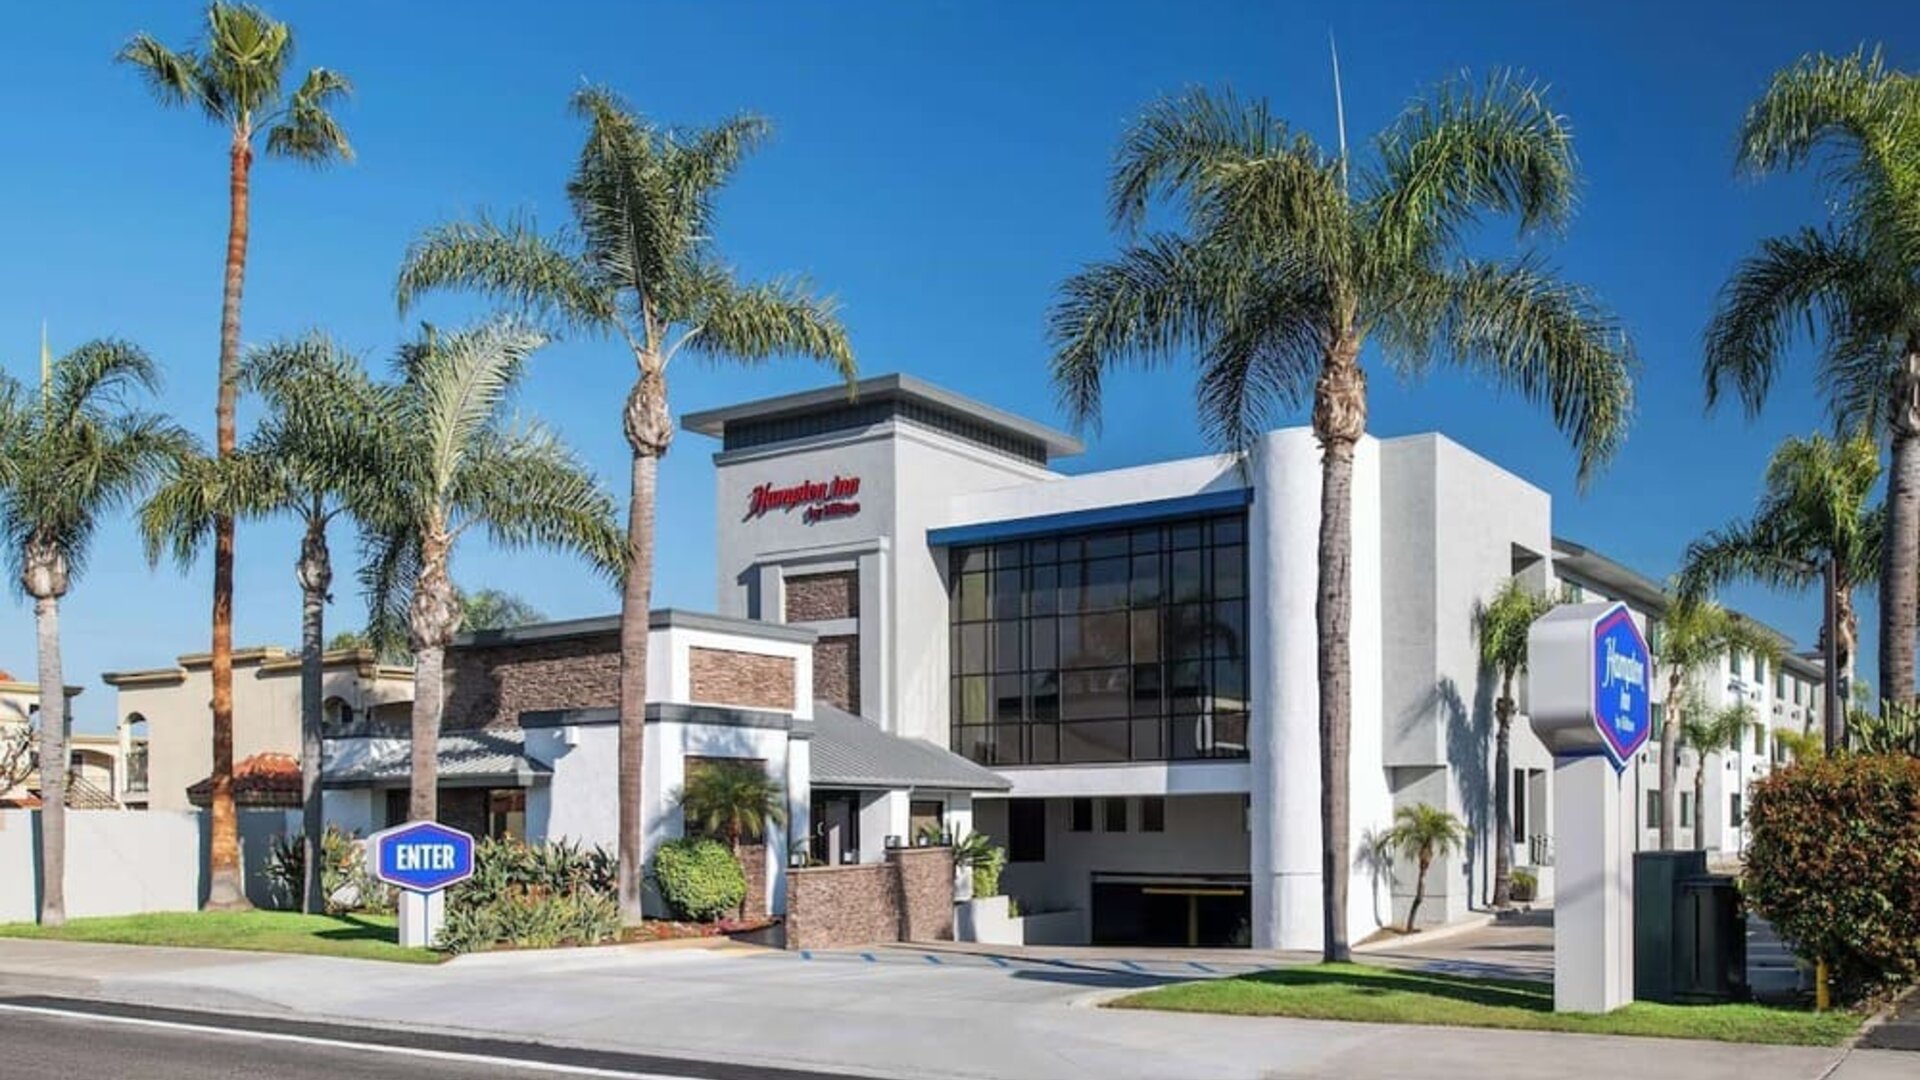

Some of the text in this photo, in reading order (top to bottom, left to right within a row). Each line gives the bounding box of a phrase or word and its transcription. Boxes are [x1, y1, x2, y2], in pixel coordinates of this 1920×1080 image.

[742, 475, 861, 522] Hampton Inn
[1601, 636, 1645, 693] Hampton
[396, 844, 455, 870] ENTER
